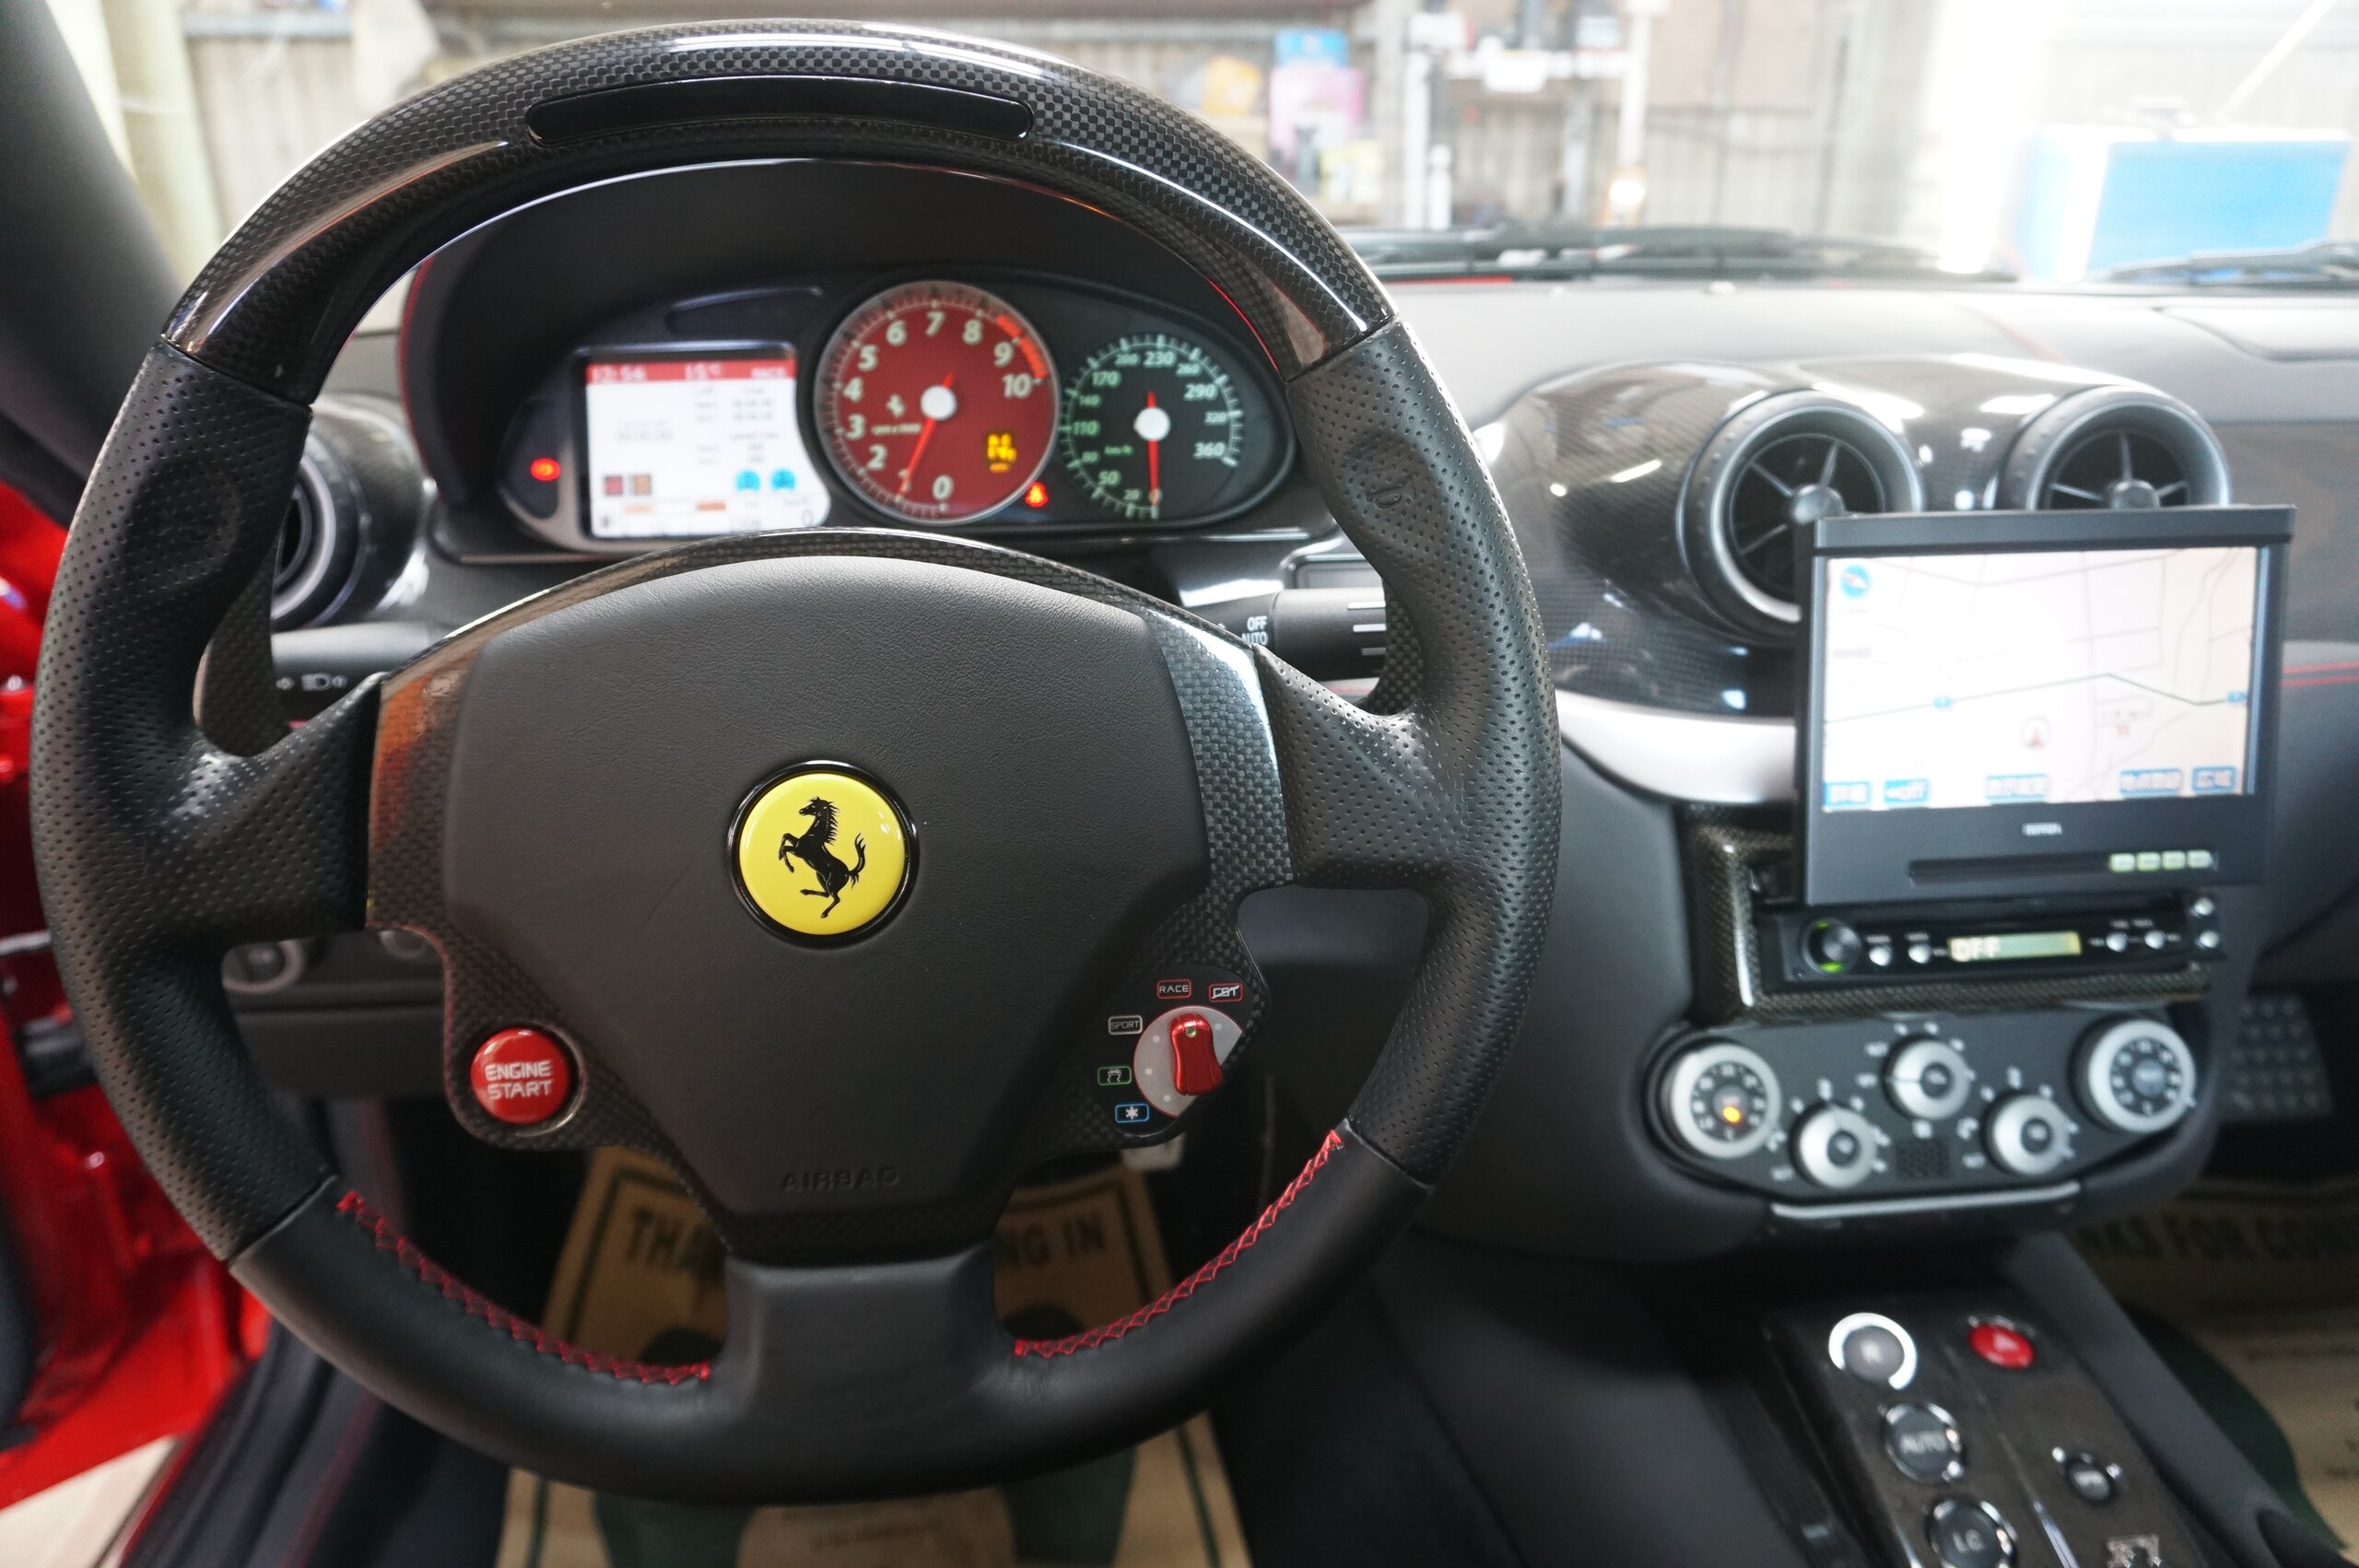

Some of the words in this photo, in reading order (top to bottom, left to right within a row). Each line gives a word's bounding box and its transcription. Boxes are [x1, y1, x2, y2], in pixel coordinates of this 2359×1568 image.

[886, 320, 908, 345] 6
[926, 310, 945, 336] 7
[963, 319, 982, 345] 8
[857, 345, 878, 371] 5
[993, 341, 1013, 367] 9
[1115, 353, 1140, 366] 200
[1144, 351, 1176, 368] 230
[1092, 370, 1121, 387] 170
[1176, 361, 1201, 376] 260
[842, 377, 863, 403] 4
[1002, 373, 1032, 398] 10
[1183, 383, 1217, 401] 290
[846, 414, 865, 440] 3
[1073, 420, 1100, 437] 110
[867, 443, 886, 471] 2
[1193, 442, 1226, 459] 360
[933, 474, 953, 500] 0
[1098, 470, 1121, 486] 50
[1247, 614, 1268, 631] OFF
[1951, 936, 2001, 963] OFF
[1158, 983, 1190, 994] RACE
[1109, 1019, 1140, 1030] SPORT
[485, 1060, 551, 1081] ENGINE
[487, 1080, 553, 1100] START
[781, 1166, 901, 1193] AIRBAG
